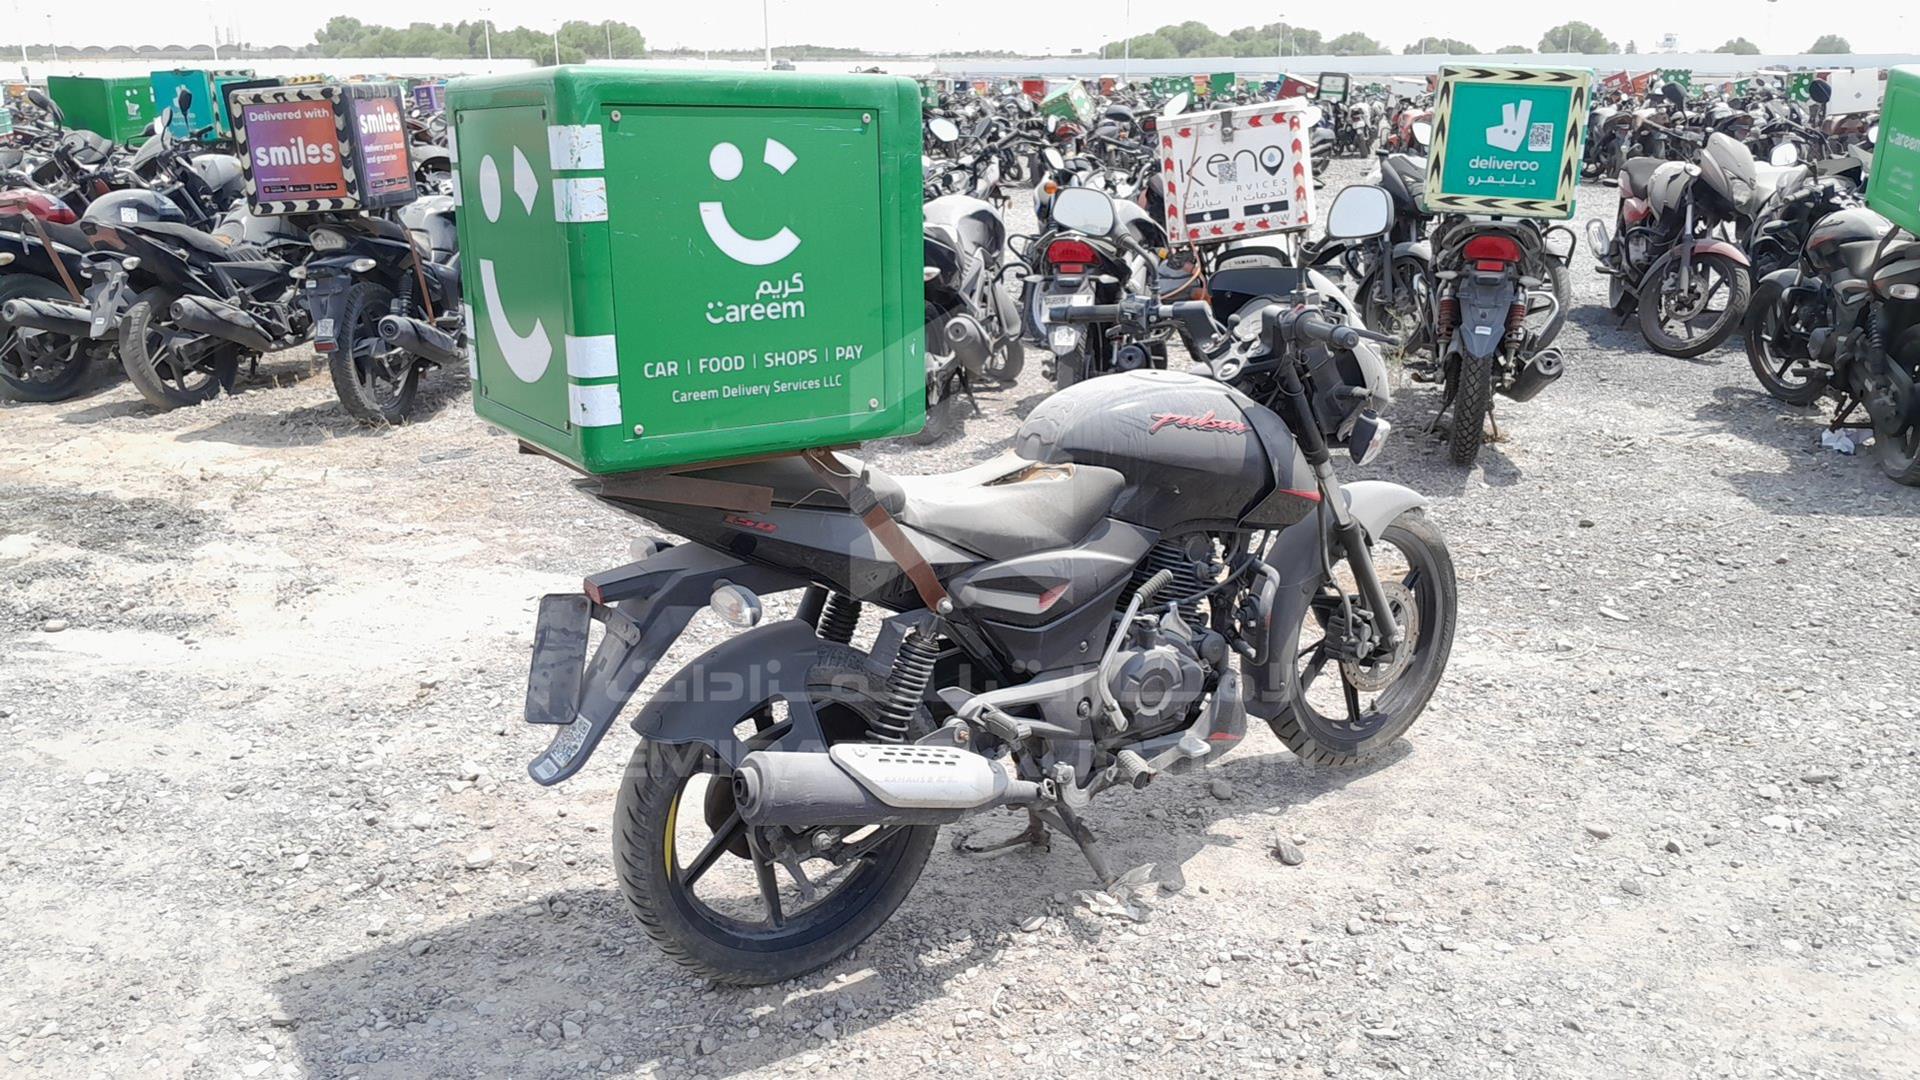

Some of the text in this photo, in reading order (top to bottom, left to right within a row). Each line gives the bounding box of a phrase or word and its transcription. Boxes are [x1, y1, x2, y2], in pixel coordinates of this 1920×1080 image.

[249, 108, 329, 121] Delivered with
[360, 105, 401, 134] smiles
[255, 136, 336, 167] smiles
[1468, 155, 1539, 171] deliveroo
[1235, 178, 1288, 192] RVICES
[755, 272, 805, 300] كريم
[705, 300, 805, 324] Careem
[643, 344, 864, 379] CAR FOOD SHOPS PAY
[672, 374, 842, 404] Careem Delivery Services LLC
